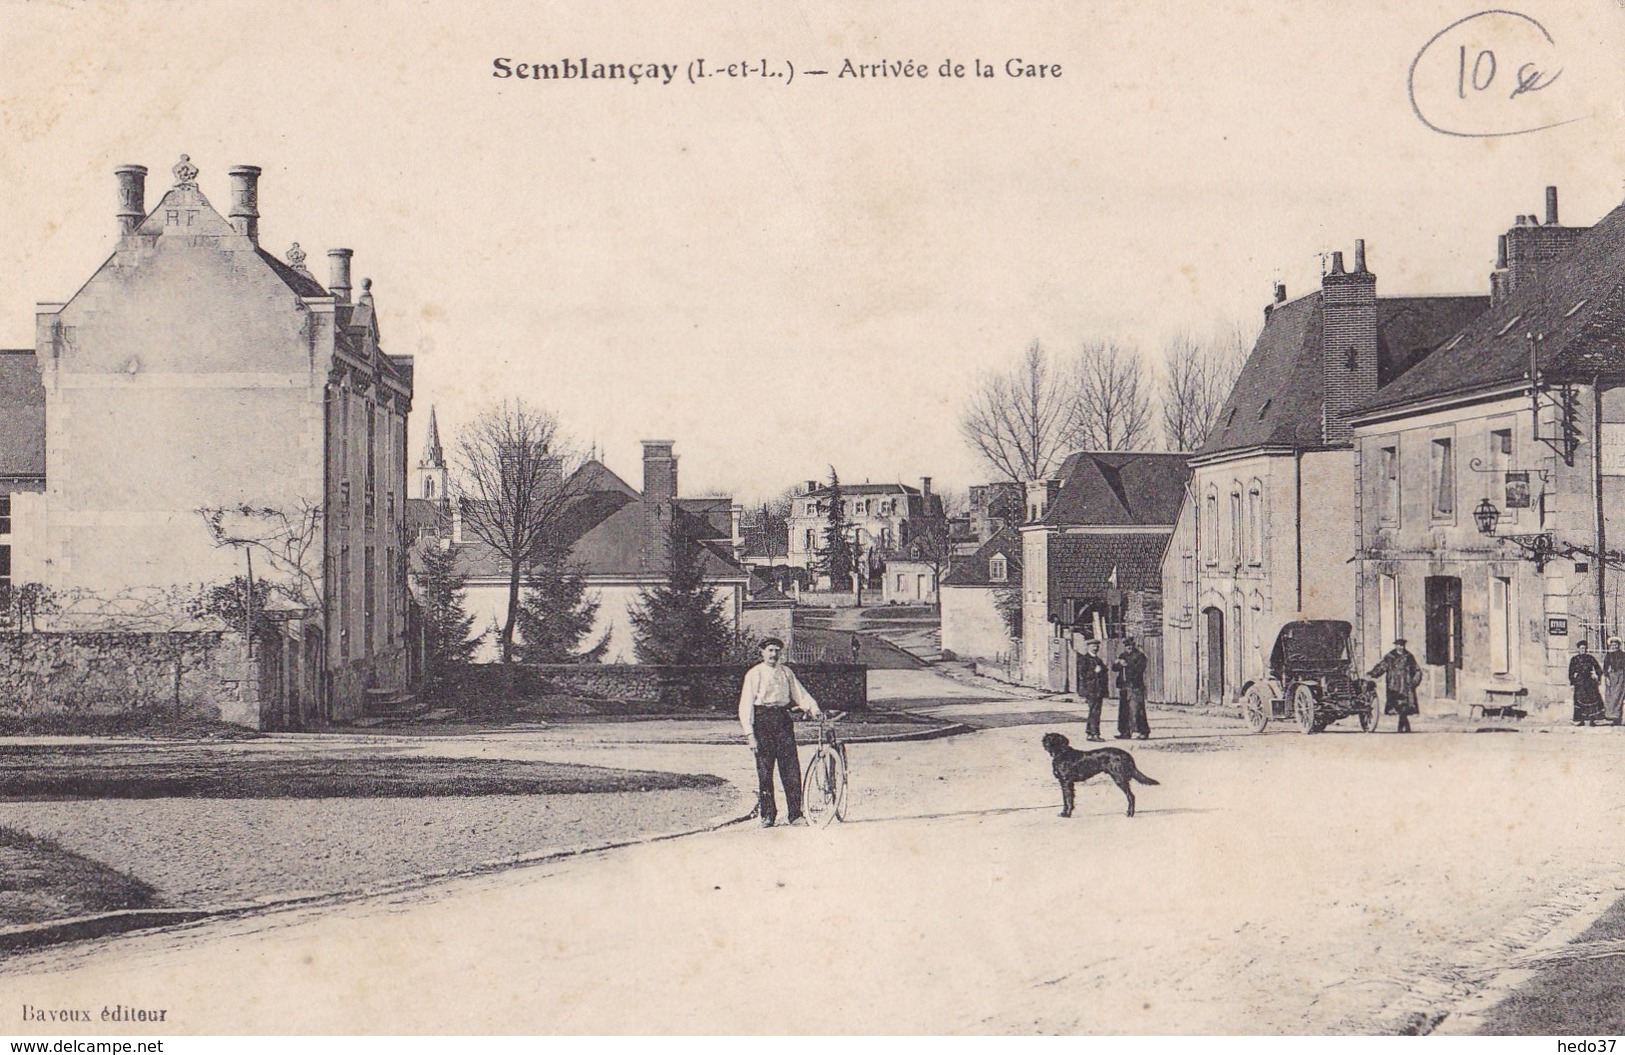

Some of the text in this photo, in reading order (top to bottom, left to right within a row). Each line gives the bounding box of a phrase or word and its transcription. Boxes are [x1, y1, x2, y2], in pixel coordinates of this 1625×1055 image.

[492, 57, 678, 86] Semblançay
[838, 57, 928, 79] Arrivée
[938, 58, 965, 79] de
[975, 58, 994, 79] la
[1005, 58, 1062, 79] Gare
[1458, 45, 1498, 100] 10
[101, 1003, 167, 1022] éditeur
